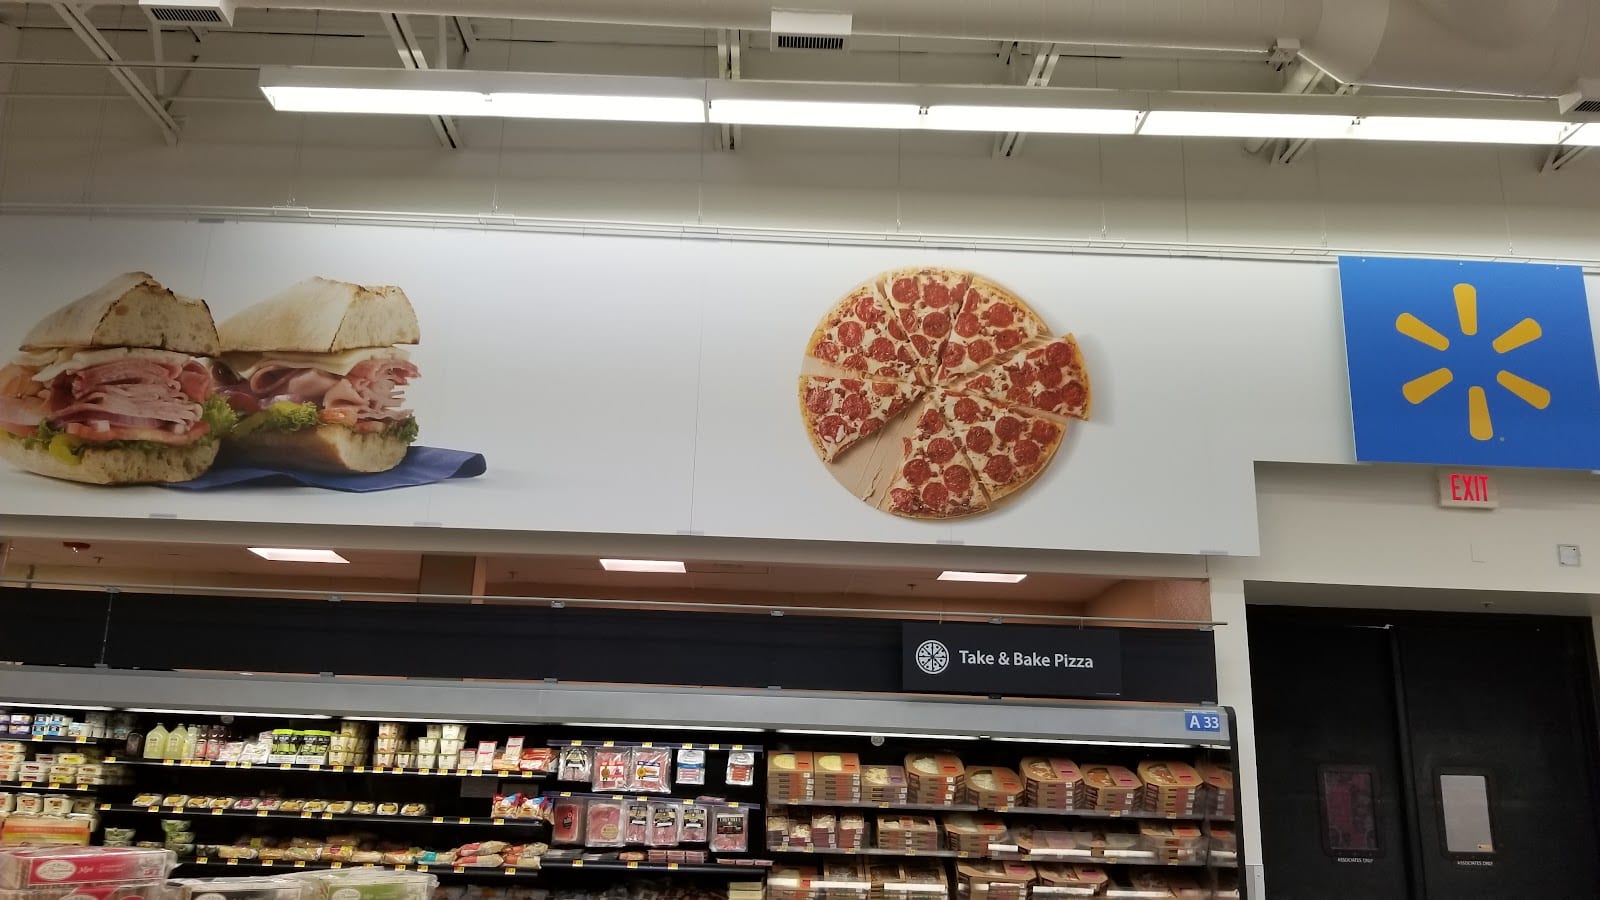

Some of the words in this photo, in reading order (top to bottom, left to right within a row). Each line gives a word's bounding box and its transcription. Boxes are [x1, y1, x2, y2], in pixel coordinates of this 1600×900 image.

[1450, 474, 1488, 502] EXIT
[959, 650, 995, 665] Take
[998, 651, 1010, 666] &
[1013, 652, 1051, 667] Bake
[1054, 653, 1093, 668] Pizza
[1190, 715, 1201, 729] A
[1203, 716, 1219, 729] 33
